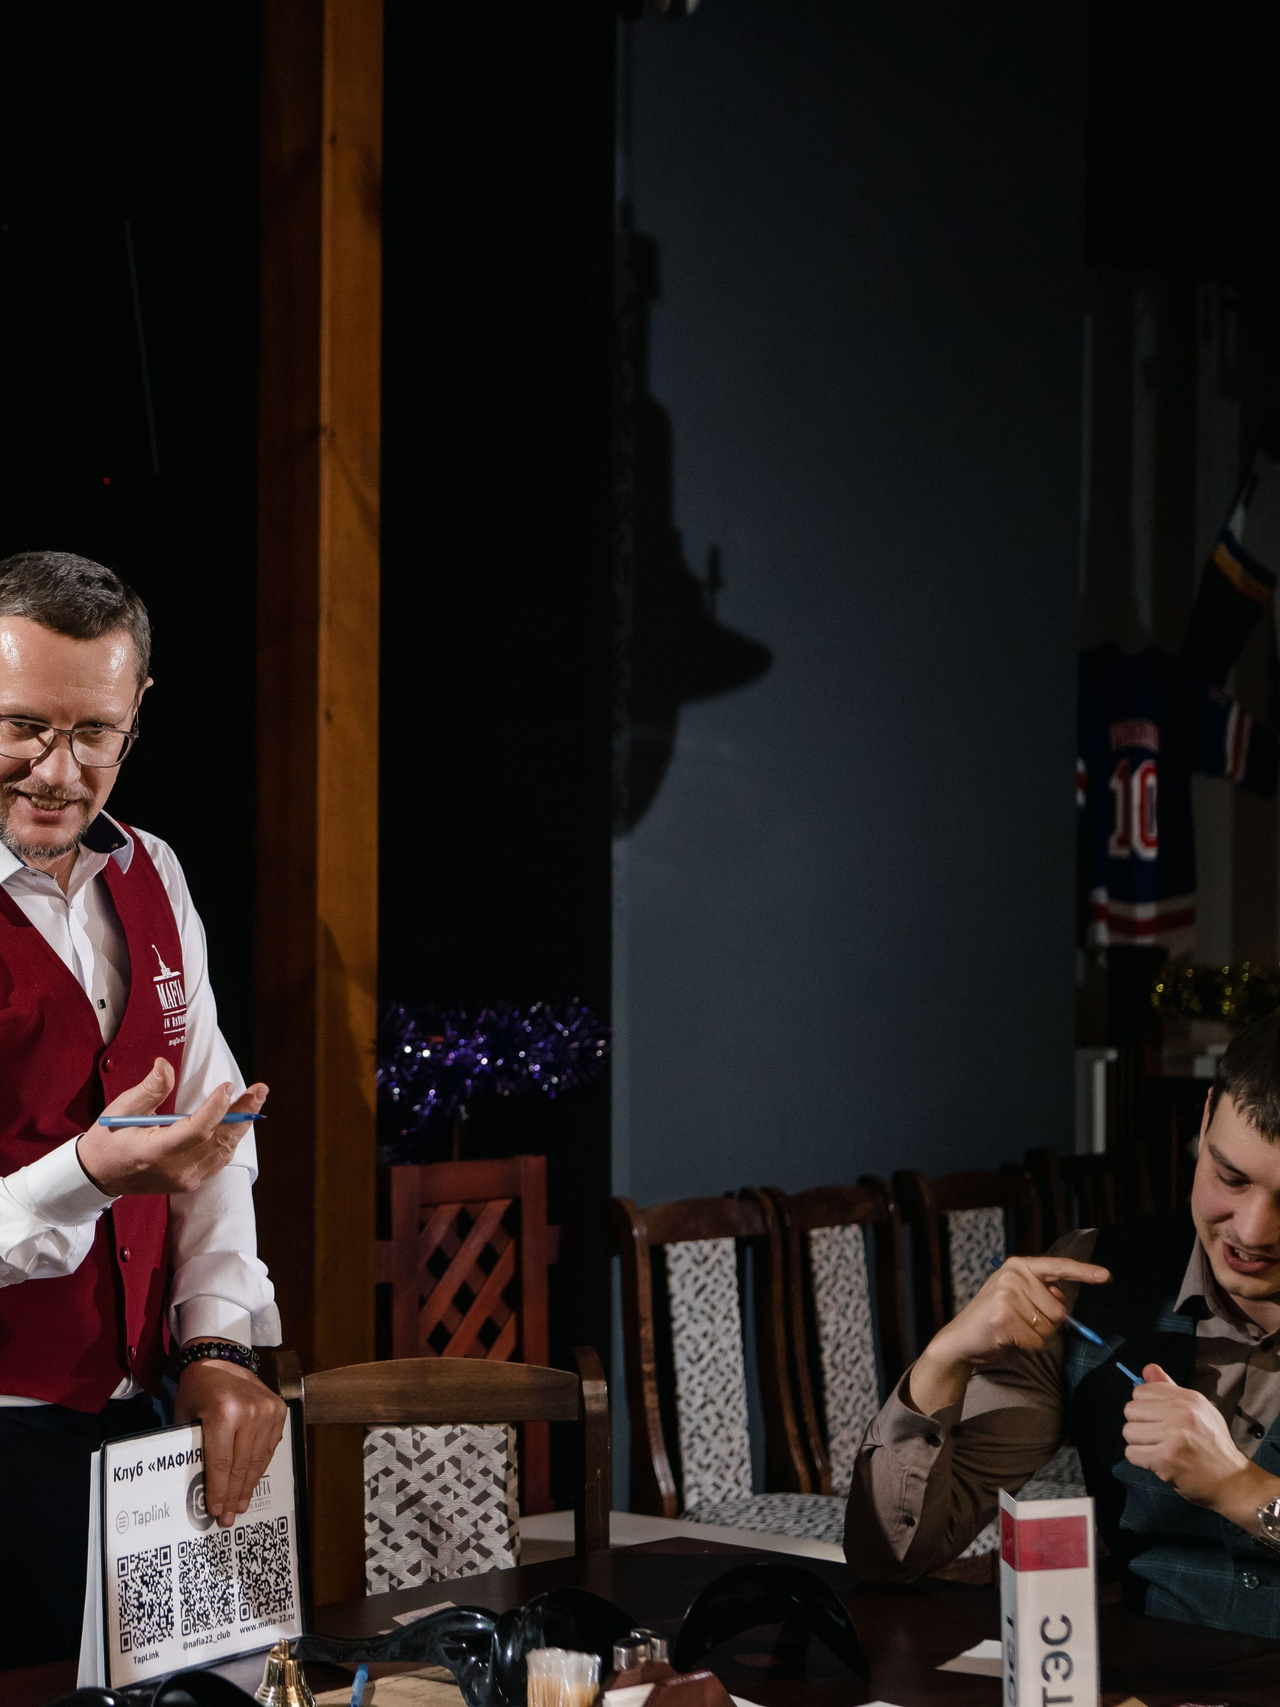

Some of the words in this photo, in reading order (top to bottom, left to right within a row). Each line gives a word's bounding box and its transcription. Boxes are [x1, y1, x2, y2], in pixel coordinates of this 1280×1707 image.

[156, 979, 186, 1010] MAFIA
[113, 1461, 144, 1482] Клуб
[147, 1448, 203, 1472] «МАФИЯ
[132, 1502, 170, 1527] Taplink
[240, 1613, 296, 1634] www.mafia-22.ru
[133, 1651, 160, 1665] TapLink
